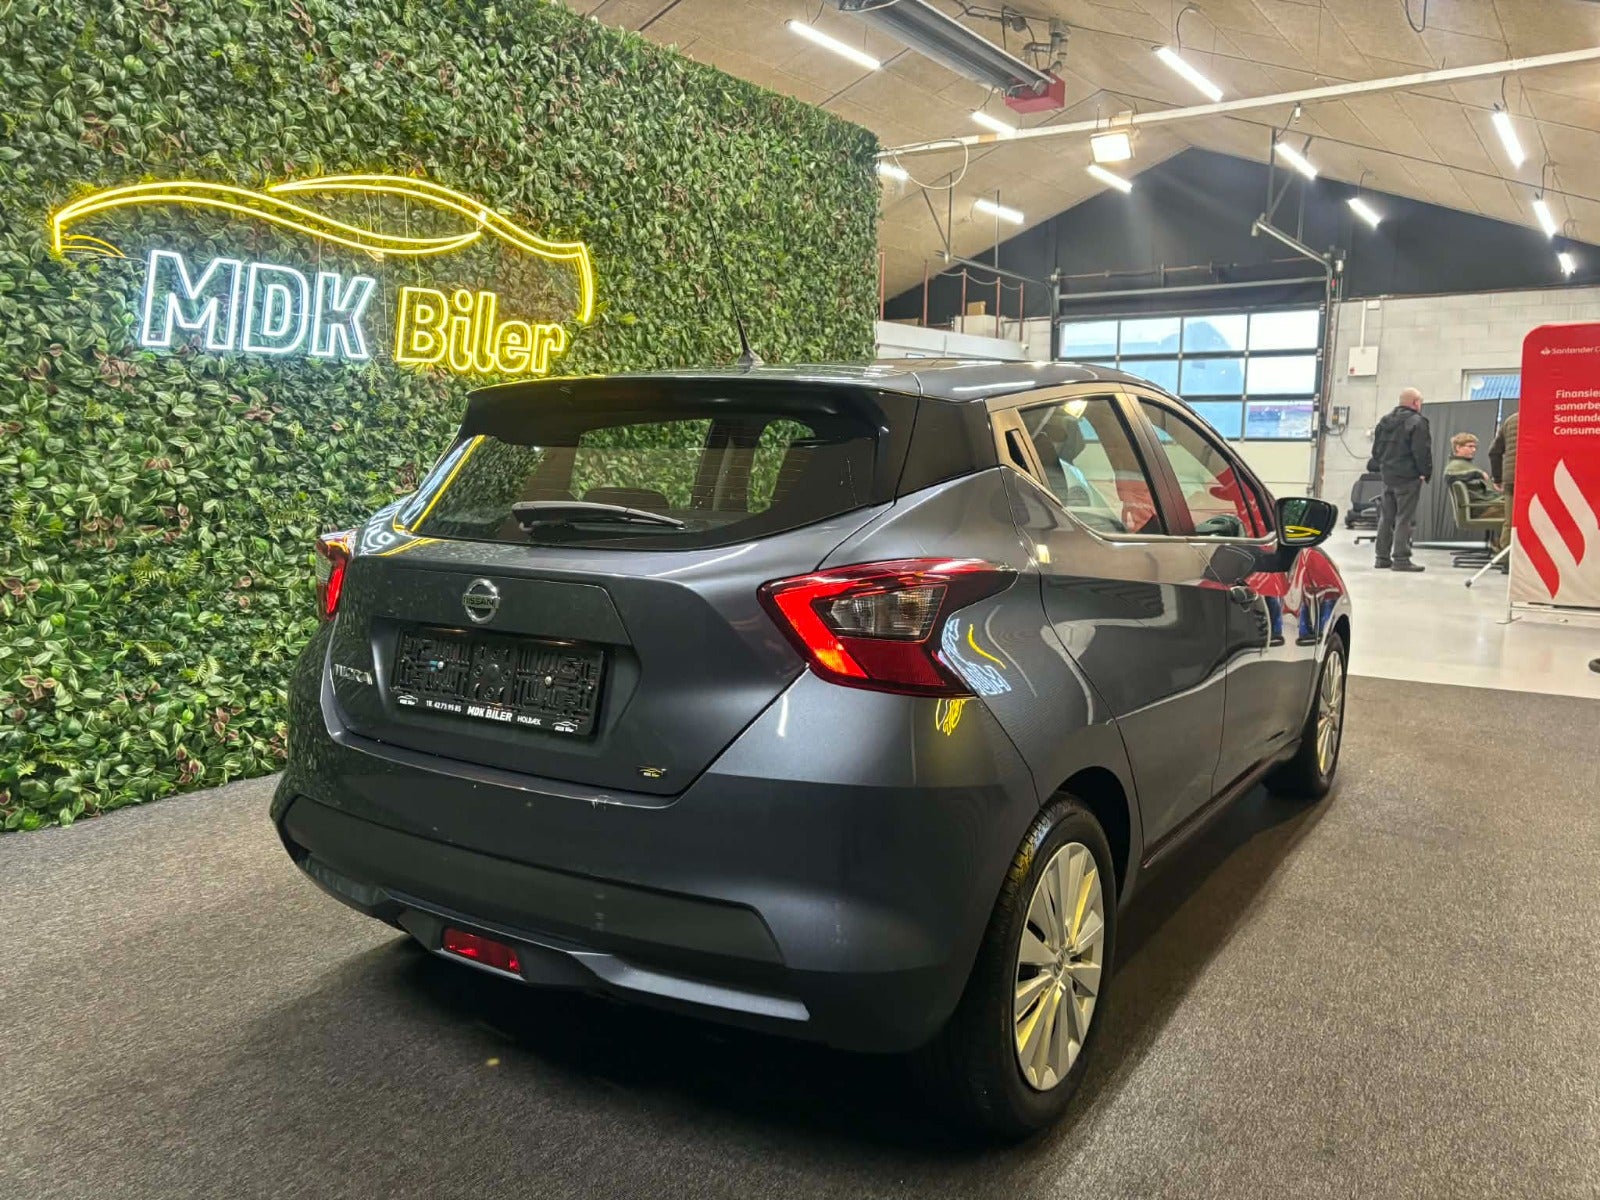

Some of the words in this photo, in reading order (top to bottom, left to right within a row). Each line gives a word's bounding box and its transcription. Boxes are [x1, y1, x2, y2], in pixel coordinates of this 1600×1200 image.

[139, 248, 376, 360] MDK
[394, 285, 566, 374] Biler
[1551, 346, 1593, 355] Santander
[1555, 388, 1600, 399] Finansie
[1553, 426, 1600, 435] Consume
[463, 595, 495, 606] NISSAN
[467, 705, 486, 718] MDK
[485, 708, 512, 722] BILER
